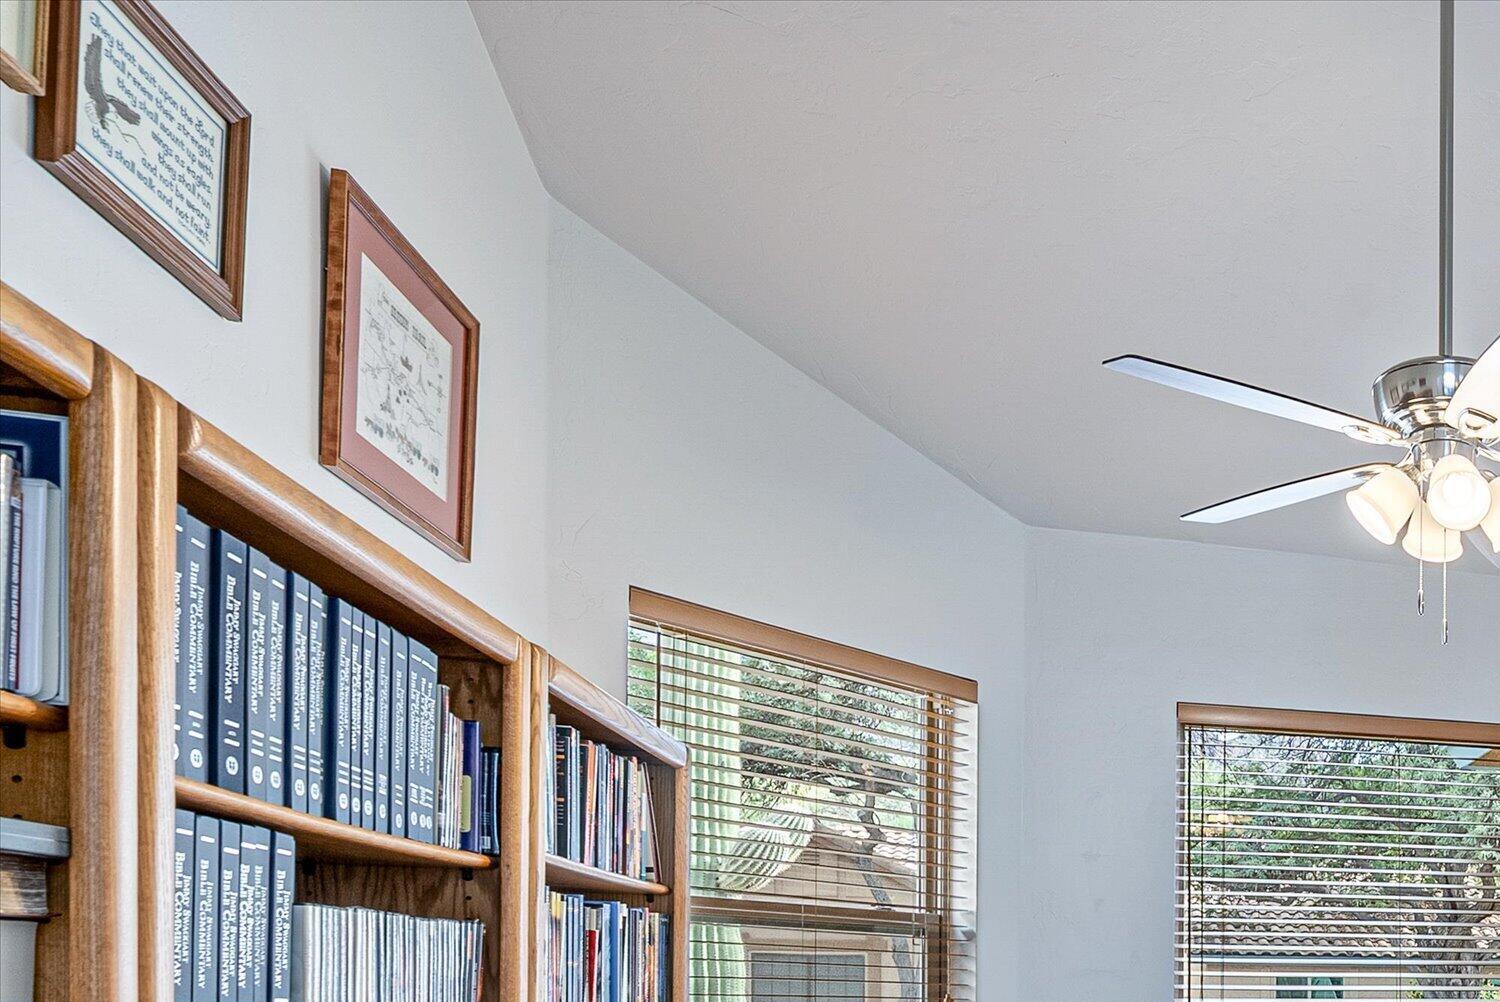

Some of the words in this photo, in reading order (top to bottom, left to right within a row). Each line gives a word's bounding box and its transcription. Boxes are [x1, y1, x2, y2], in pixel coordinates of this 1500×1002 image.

[104, 49, 126, 74] shall
[127, 71, 153, 101] renew
[156, 98, 175, 122] their
[117, 39, 137, 66] that
[138, 64, 156, 87] wait
[158, 84, 178, 110] upon
[180, 106, 193, 125] the
[117, 76, 136, 107] they
[138, 101, 158, 124] shall
[160, 123, 185, 151] mount
[186, 148, 196, 164] up
[198, 160, 213, 179] with
[151, 131, 173, 157] wings
[175, 155, 185, 168] as
[92, 127, 112, 158] they
[115, 151, 135, 174] shall
[137, 171, 155, 192] walk
[157, 190, 172, 209] and
[176, 207, 189, 223] not
[142, 158, 157, 177] and
[160, 174, 173, 191] not
[175, 185, 184, 200] be
[158, 152, 176, 180] they
[179, 174, 196, 195] shall
[11, 620, 17, 630] OF
[189, 603, 198, 693] COMMENTARY
[224, 613, 234, 703] COMMENTARY
[175, 852, 185, 888] BIBLE
[223, 870, 233, 906] BIBLE
[174, 891, 184, 986] COMMENTARY
[221, 910, 231, 996] COMMENTARY
